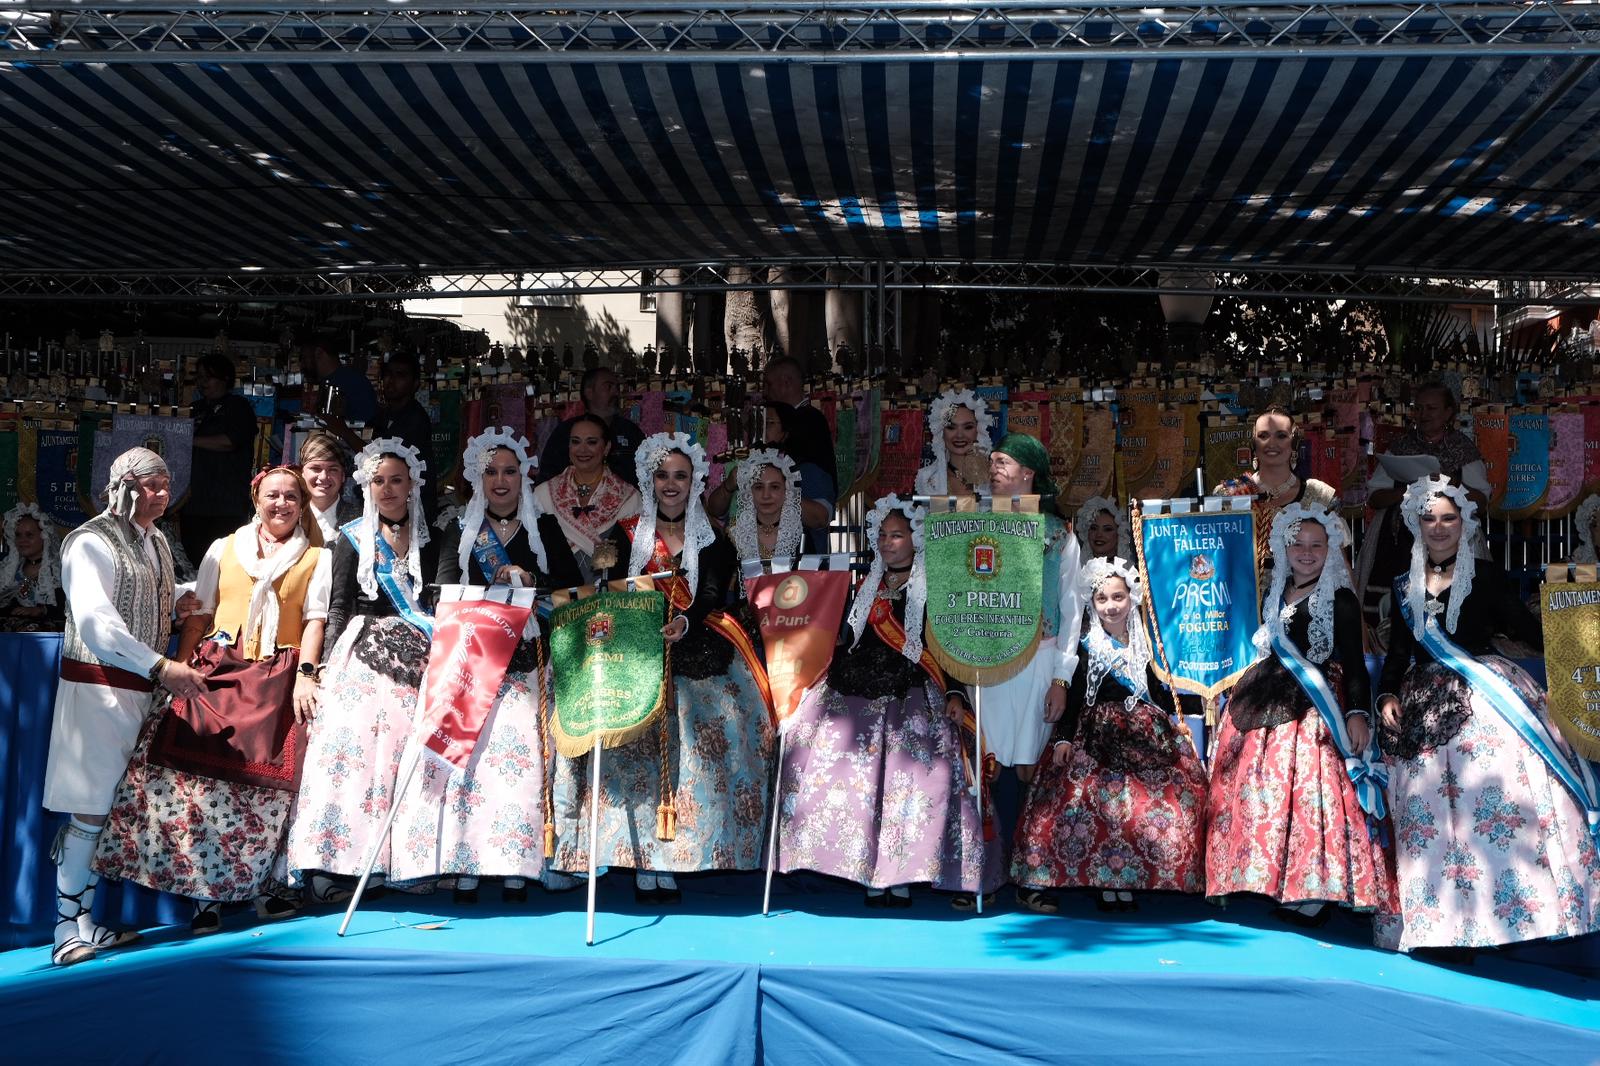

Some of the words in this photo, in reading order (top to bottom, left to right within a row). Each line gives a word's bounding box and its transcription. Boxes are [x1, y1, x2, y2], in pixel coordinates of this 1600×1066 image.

[931, 518, 986, 540] AJUNTAMENT
[1150, 523, 1188, 538] JUNTA
[1194, 518, 1246, 536] CENTRAL
[1173, 536, 1225, 553] FALLERA
[966, 590, 1022, 609] PREMI
[1171, 581, 1232, 609] PREMI
[760, 612, 770, 627] À
[774, 614, 810, 627] Punt
[935, 613, 984, 625] FOGUERES
[986, 614, 1034, 625] INFANTILS
[1178, 620, 1230, 634] FOGUERA
[1178, 660, 1220, 671] FOGUERES
